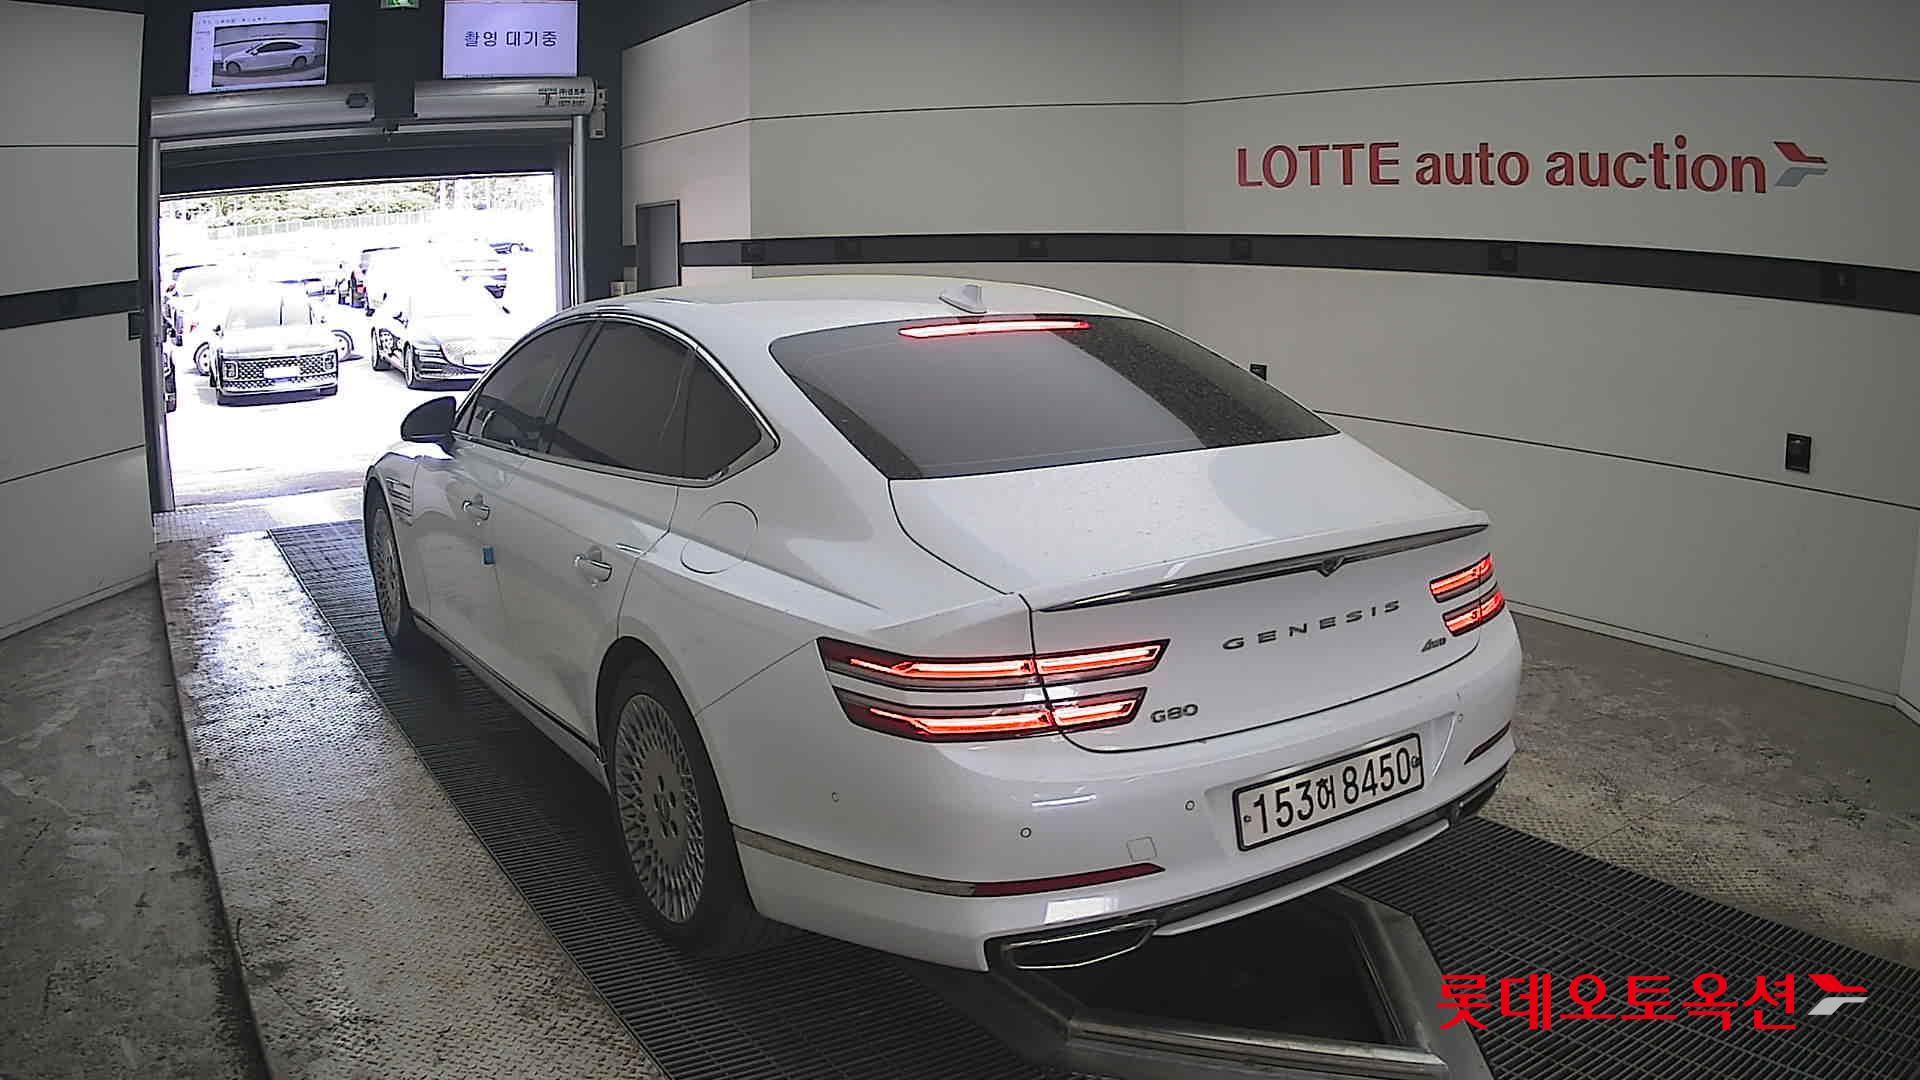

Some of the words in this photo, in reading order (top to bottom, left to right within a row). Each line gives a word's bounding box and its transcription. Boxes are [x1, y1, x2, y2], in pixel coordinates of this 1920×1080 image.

[464, 31, 498, 48] 촬영
[505, 31, 558, 48] 대기중
[1236, 142, 1400, 188] LOTTE
[1415, 143, 1530, 186] auto
[1545, 135, 1767, 193] auction
[1222, 600, 1400, 650] GENESIS
[1150, 703, 1199, 723] G80
[1252, 774, 1336, 834] 153허
[1342, 747, 1412, 805] 8450
